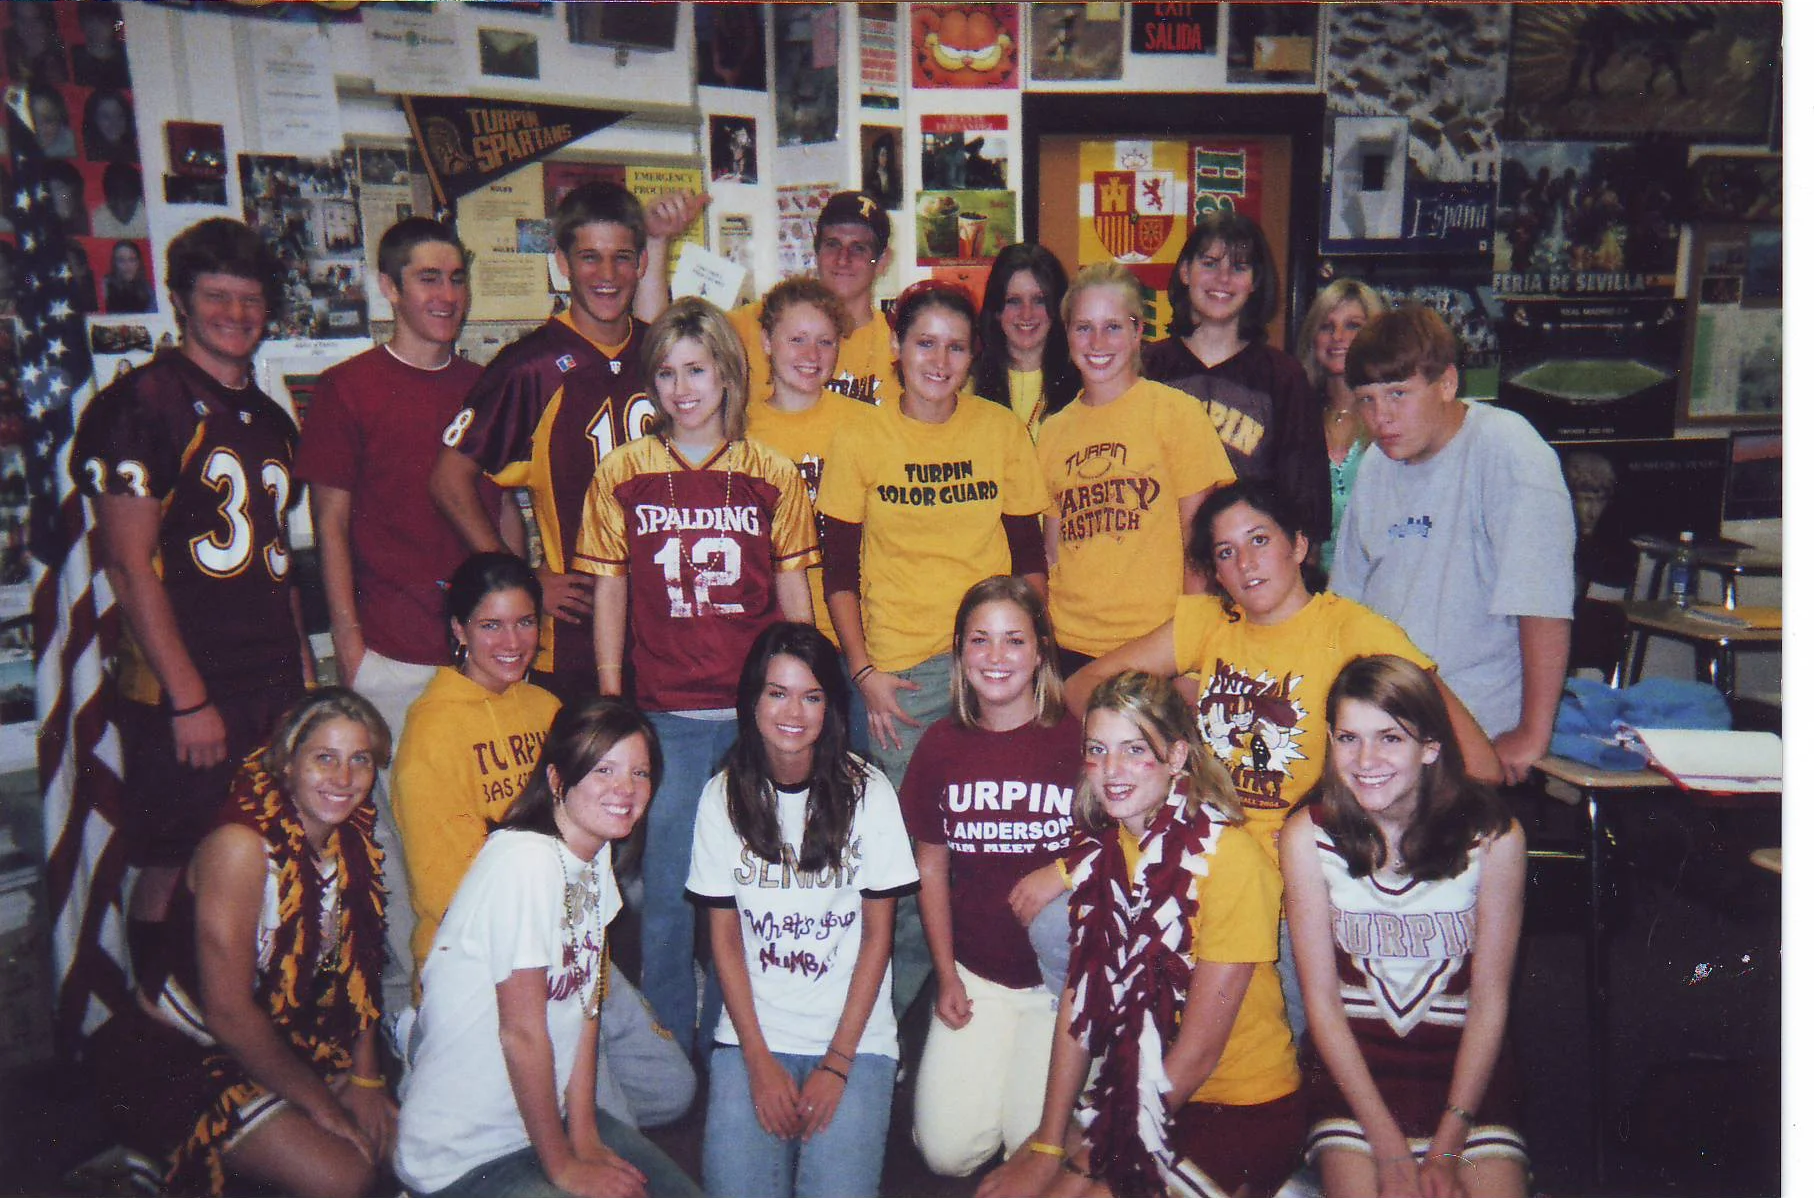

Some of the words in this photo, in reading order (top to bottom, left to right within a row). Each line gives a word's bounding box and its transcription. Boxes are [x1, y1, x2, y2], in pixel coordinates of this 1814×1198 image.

[1144, 21, 1205, 52] SALIDA
[465, 109, 540, 135] TURPIN
[472, 123, 573, 174] SPARTANS
[633, 171, 694, 183] EMERGENCY
[857, 195, 877, 218] T
[1492, 273, 1543, 293] FERIA
[1549, 273, 1571, 292] DE
[1575, 272, 1646, 292] SEVILLA
[442, 408, 477, 449] 8
[904, 459, 974, 484] TURPIN
[1065, 442, 1128, 477] TURPIN
[939, 480, 998, 504] GUARD
[635, 504, 760, 537] SPALDING
[653, 537, 746, 618] 12
[473, 730, 548, 775] TURPI
[940, 781, 1074, 816] URPIN
[953, 816, 1074, 841] ANDERSON
[743, 908, 815, 942] What's
